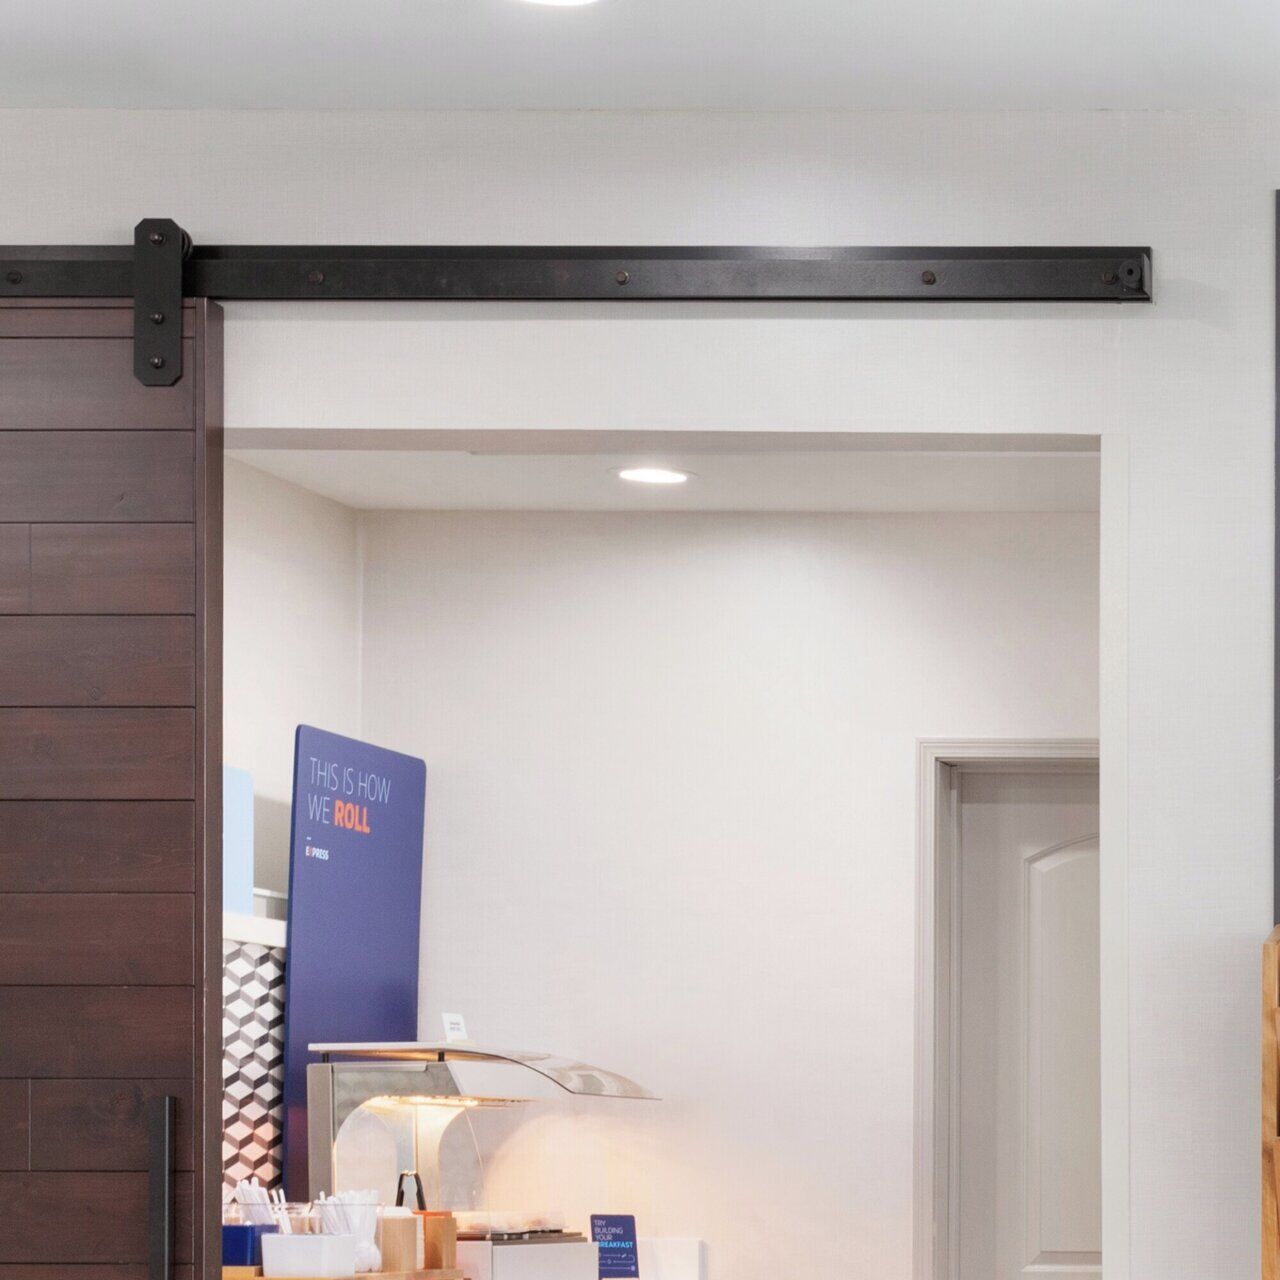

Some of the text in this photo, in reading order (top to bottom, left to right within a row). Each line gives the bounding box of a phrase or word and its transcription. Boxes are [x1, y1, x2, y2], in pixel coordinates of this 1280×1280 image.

[309, 757, 391, 804] THIS IS HOW
[308, 793, 371, 834] WE ROLL
[594, 1227, 624, 1235] BUILDING
